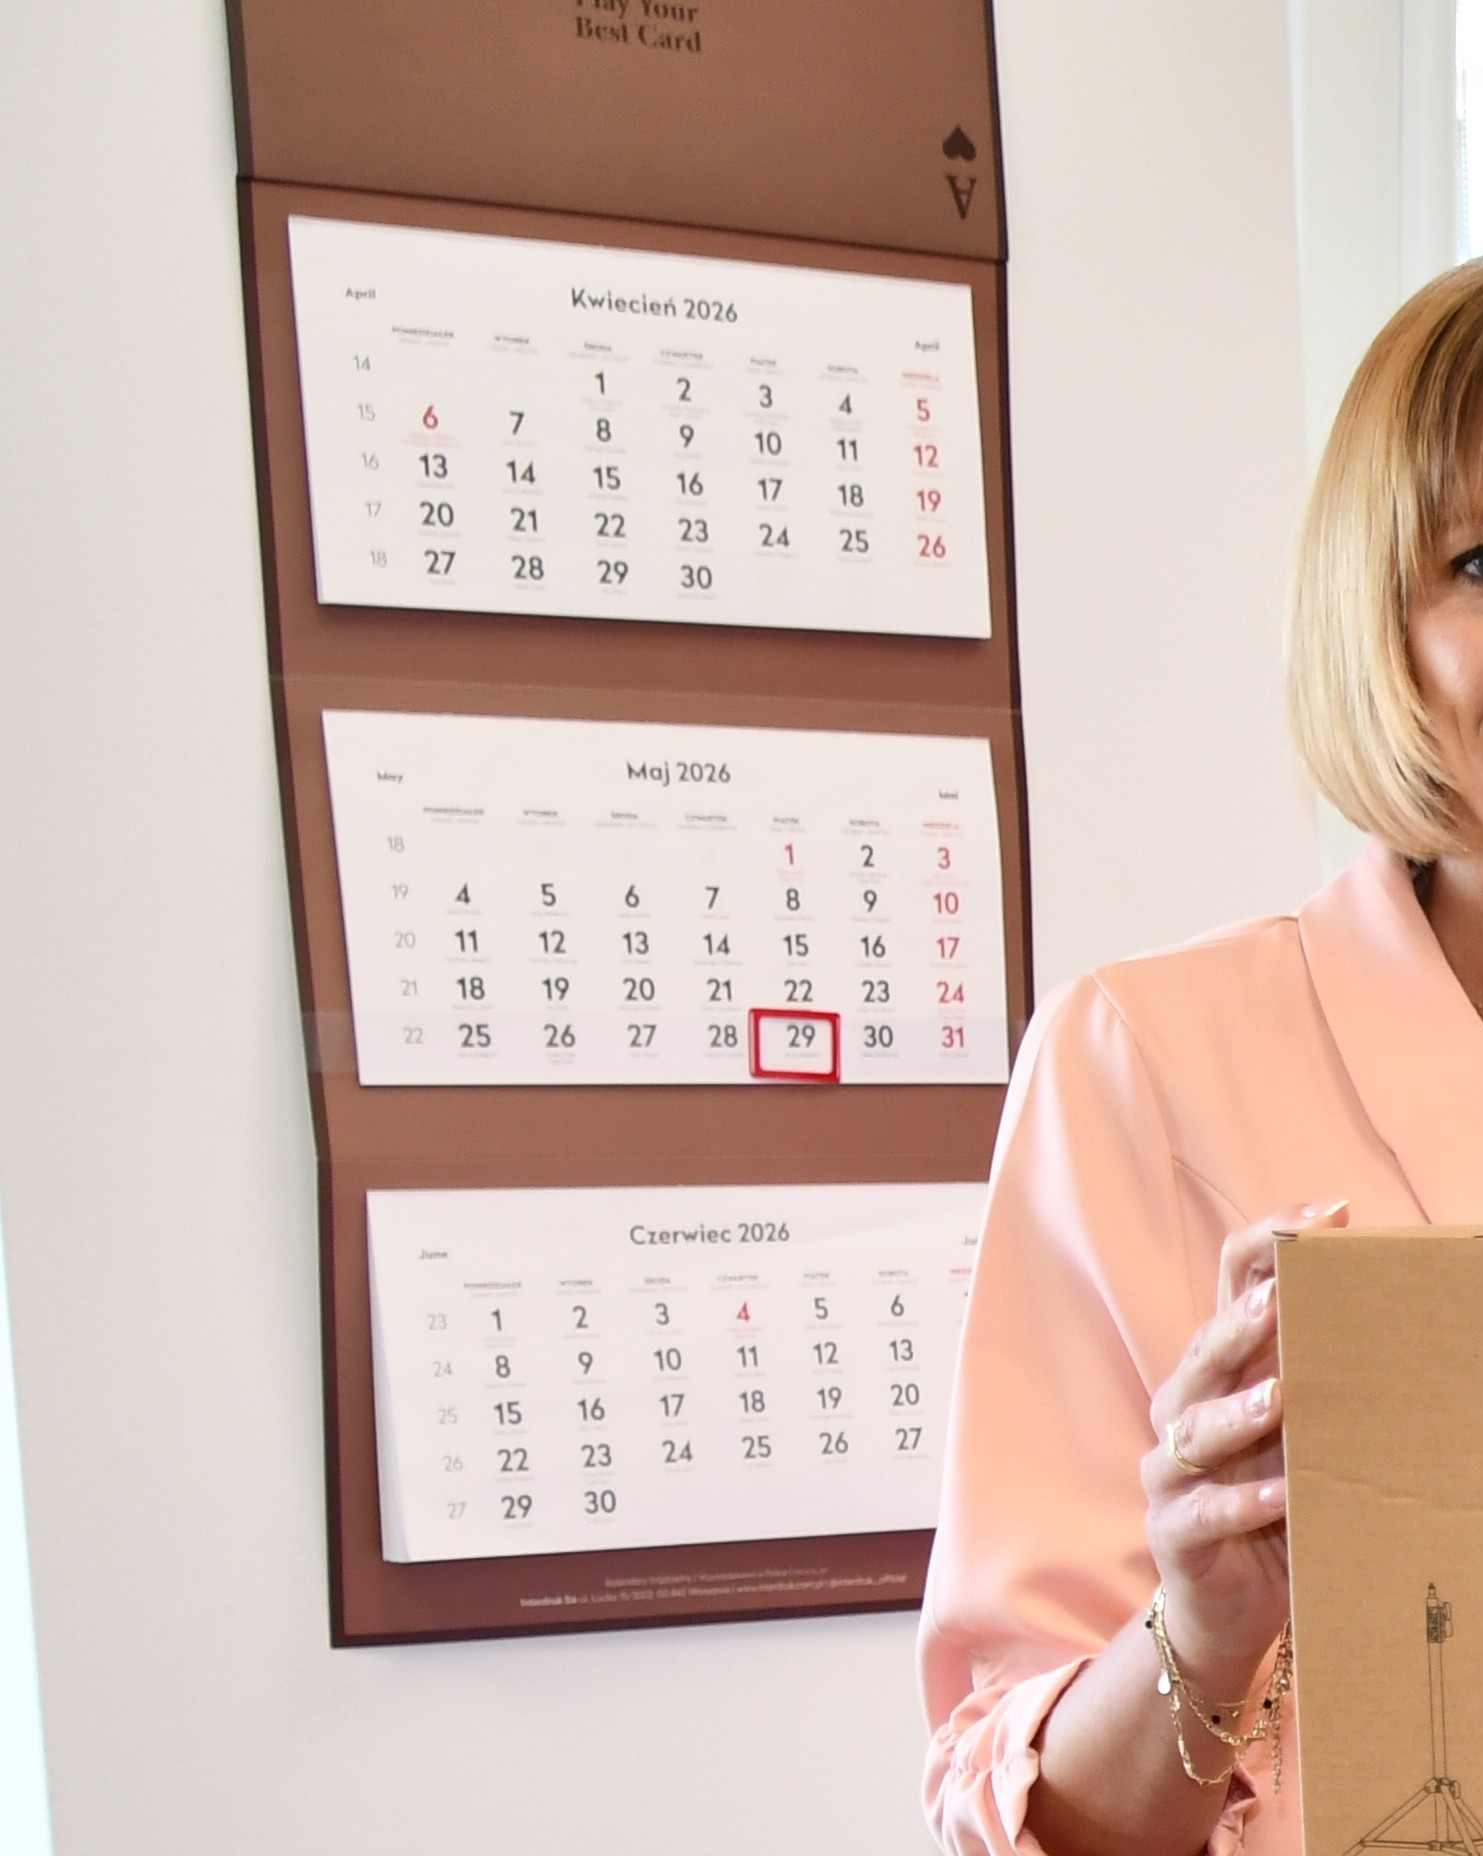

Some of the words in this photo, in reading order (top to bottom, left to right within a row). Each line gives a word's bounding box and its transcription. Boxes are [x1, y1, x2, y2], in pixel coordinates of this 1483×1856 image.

[576, 16, 628, 43] Best
[638, 25, 701, 52] Card
[571, 287, 677, 317] Kwiecień
[683, 298, 738, 323] 2026
[594, 371, 605, 395] 1
[676, 377, 691, 402] 2
[759, 384, 773, 409] 3
[839, 394, 853, 414] 4
[916, 398, 931, 422] 5
[422, 405, 439, 430] 6
[509, 411, 525, 435] 7
[596, 418, 612, 443] 8
[679, 424, 695, 448] 9
[754, 431, 782, 456] 10
[837, 438, 858, 462] 11
[913, 444, 939, 468] 12
[419, 454, 448, 479] 13
[506, 460, 536, 484] 14
[593, 466, 621, 490] 15
[676, 472, 704, 496] 16
[757, 477, 783, 501] 17
[838, 484, 864, 508] 18
[916, 489, 942, 513] 19
[419, 501, 454, 527] 20
[510, 507, 538, 532] 21
[594, 512, 626, 538] 22
[678, 517, 709, 543] 23
[759, 523, 790, 547] 24
[839, 528, 869, 553] 25
[917, 534, 946, 559] 26
[424, 549, 456, 575] 27
[511, 555, 545, 581] 28
[597, 559, 629, 584] 29
[681, 564, 713, 590] 30
[626, 763, 670, 787] Maj
[676, 762, 731, 783] 2026
[784, 843, 795, 865] 1
[860, 844, 875, 868] 2
[937, 846, 951, 870] 3
[455, 883, 471, 904] 4
[540, 883, 557, 907] 5
[624, 885, 640, 908] 6
[705, 886, 720, 910] 7
[786, 888, 801, 912] 8
[863, 889, 878, 913] 9
[933, 891, 959, 915] 10
[454, 929, 478, 952] 11
[538, 930, 566, 954] 12
[622, 931, 650, 955] 13
[703, 933, 730, 955] 14
[783, 933, 809, 957] 15
[860, 935, 886, 958] 16
[936, 936, 961, 959] 17
[456, 976, 485, 1001] 18
[542, 977, 570, 1001] 19
[622, 977, 655, 1001] 20
[706, 978, 732, 1002] 21
[784, 979, 813, 1003] 22
[861, 979, 890, 1003] 23
[936, 981, 965, 1004] 24
[458, 1023, 491, 1048] 25
[543, 1023, 576, 1048] 26
[627, 1023, 657, 1048] 27
[708, 1024, 738, 1048] 28
[786, 1023, 816, 1048] 29
[864, 1024, 894, 1048] 30
[941, 1025, 965, 1049] 31
[629, 1224, 732, 1246] Czerwiec
[738, 1222, 790, 1243] 2026
